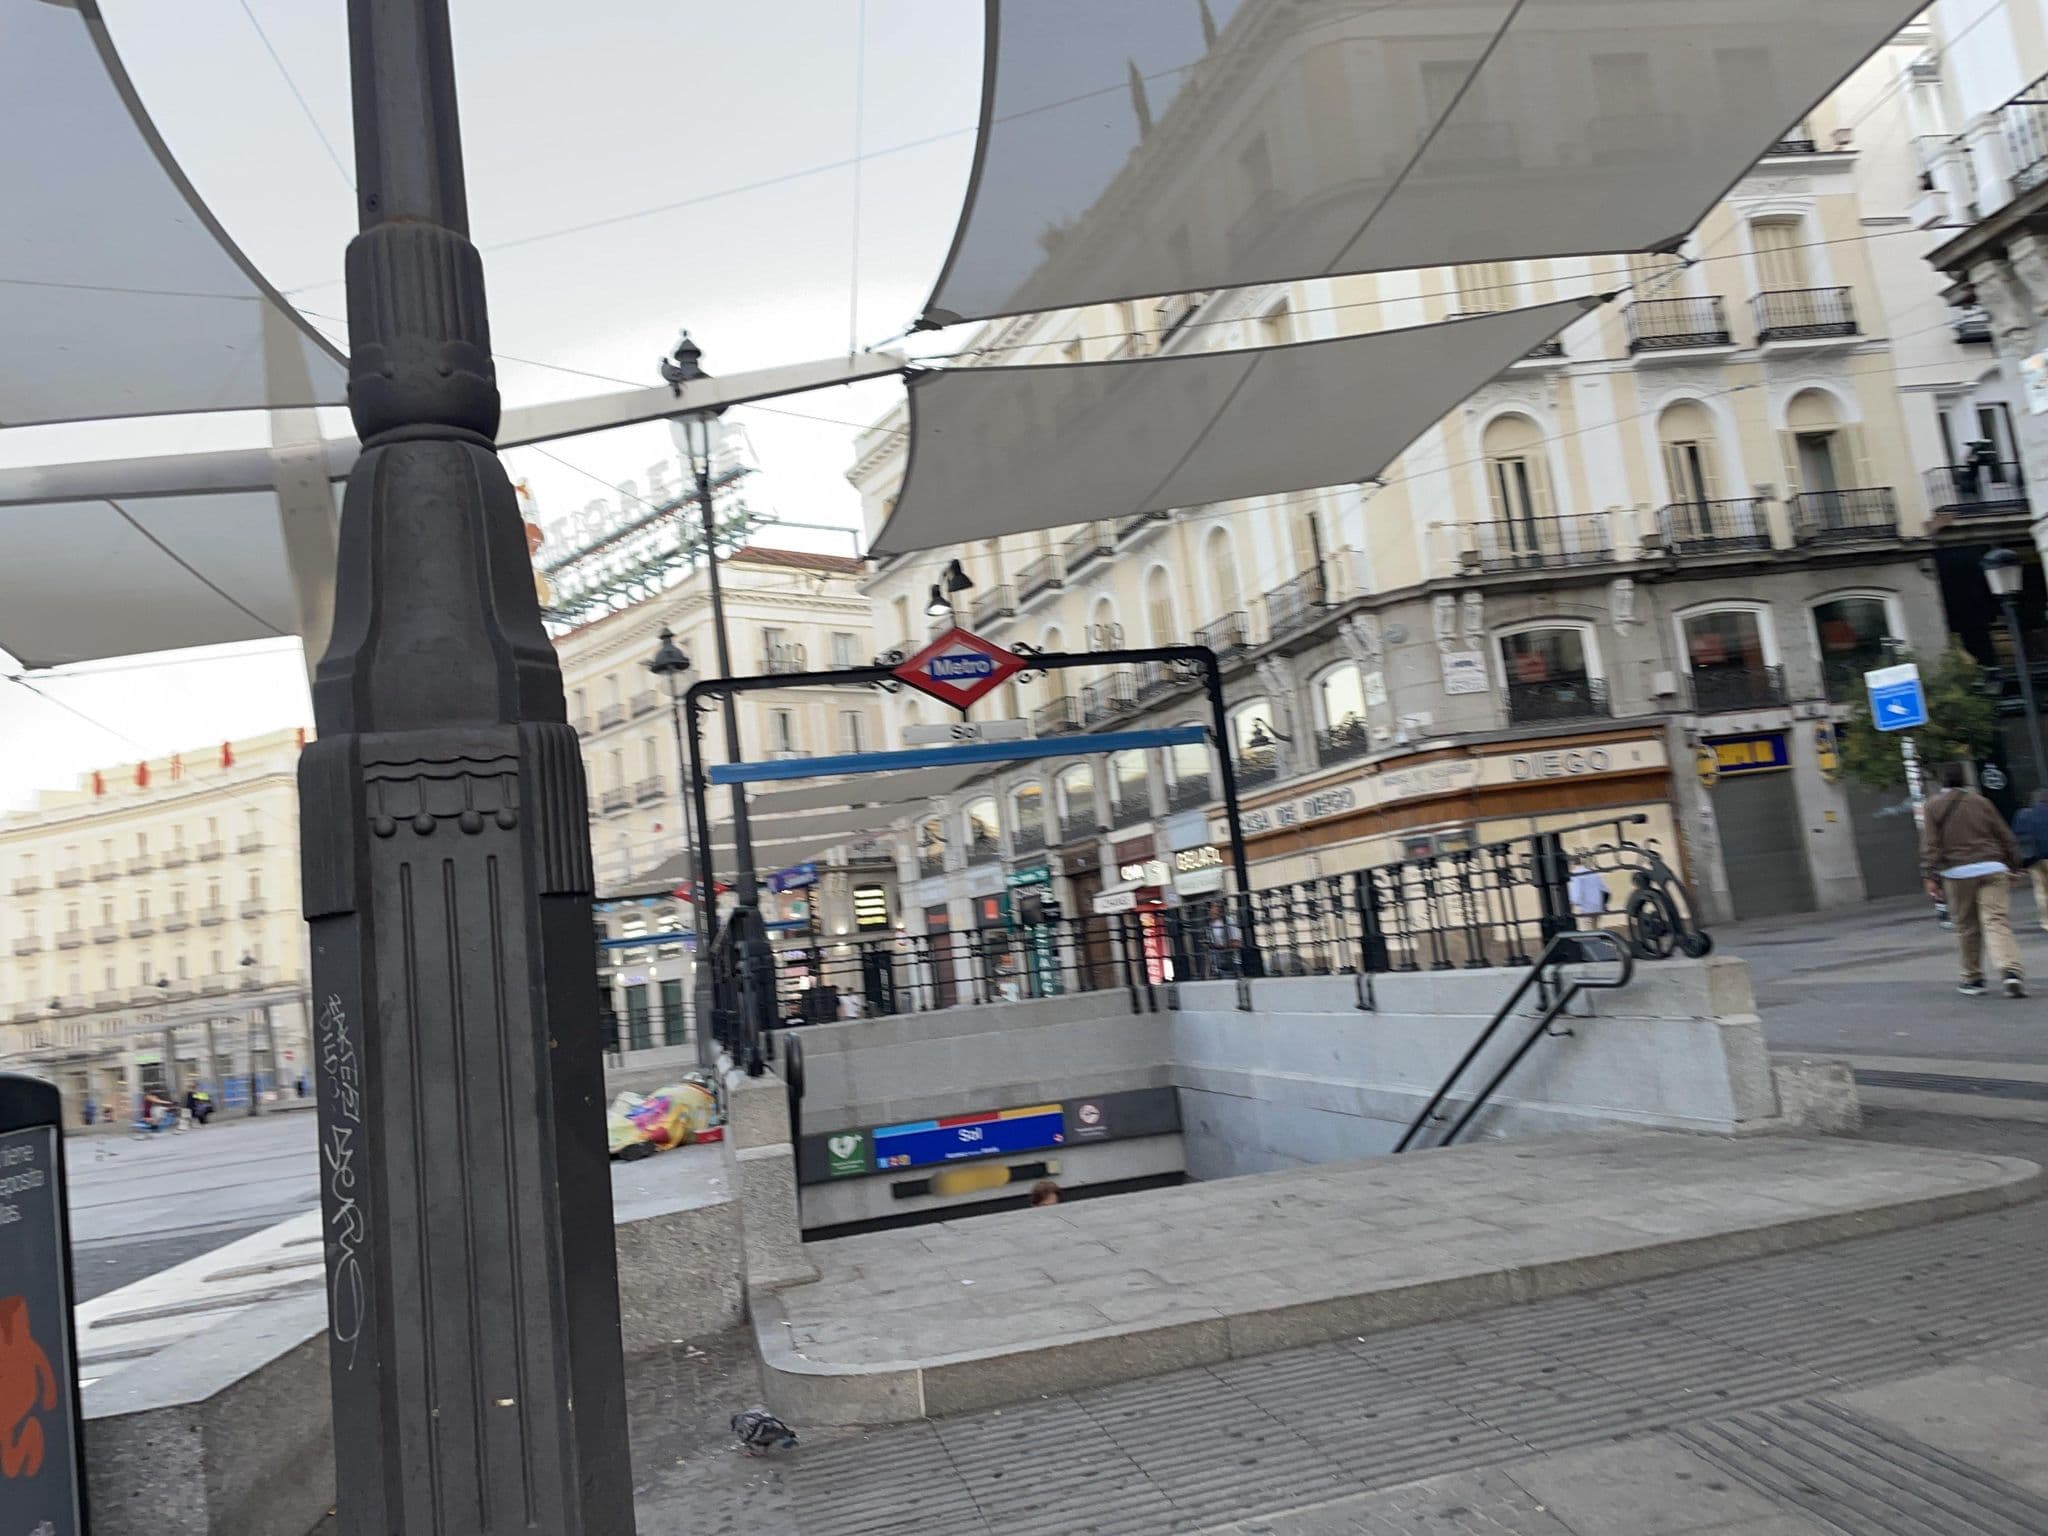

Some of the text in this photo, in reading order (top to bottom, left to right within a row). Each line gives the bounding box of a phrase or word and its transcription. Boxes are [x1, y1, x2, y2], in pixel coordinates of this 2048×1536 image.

[931, 658, 990, 677] Metro
[951, 724, 982, 740] Sol
[1510, 748, 1609, 780] DIEGO
[958, 1127, 983, 1142] Sol
